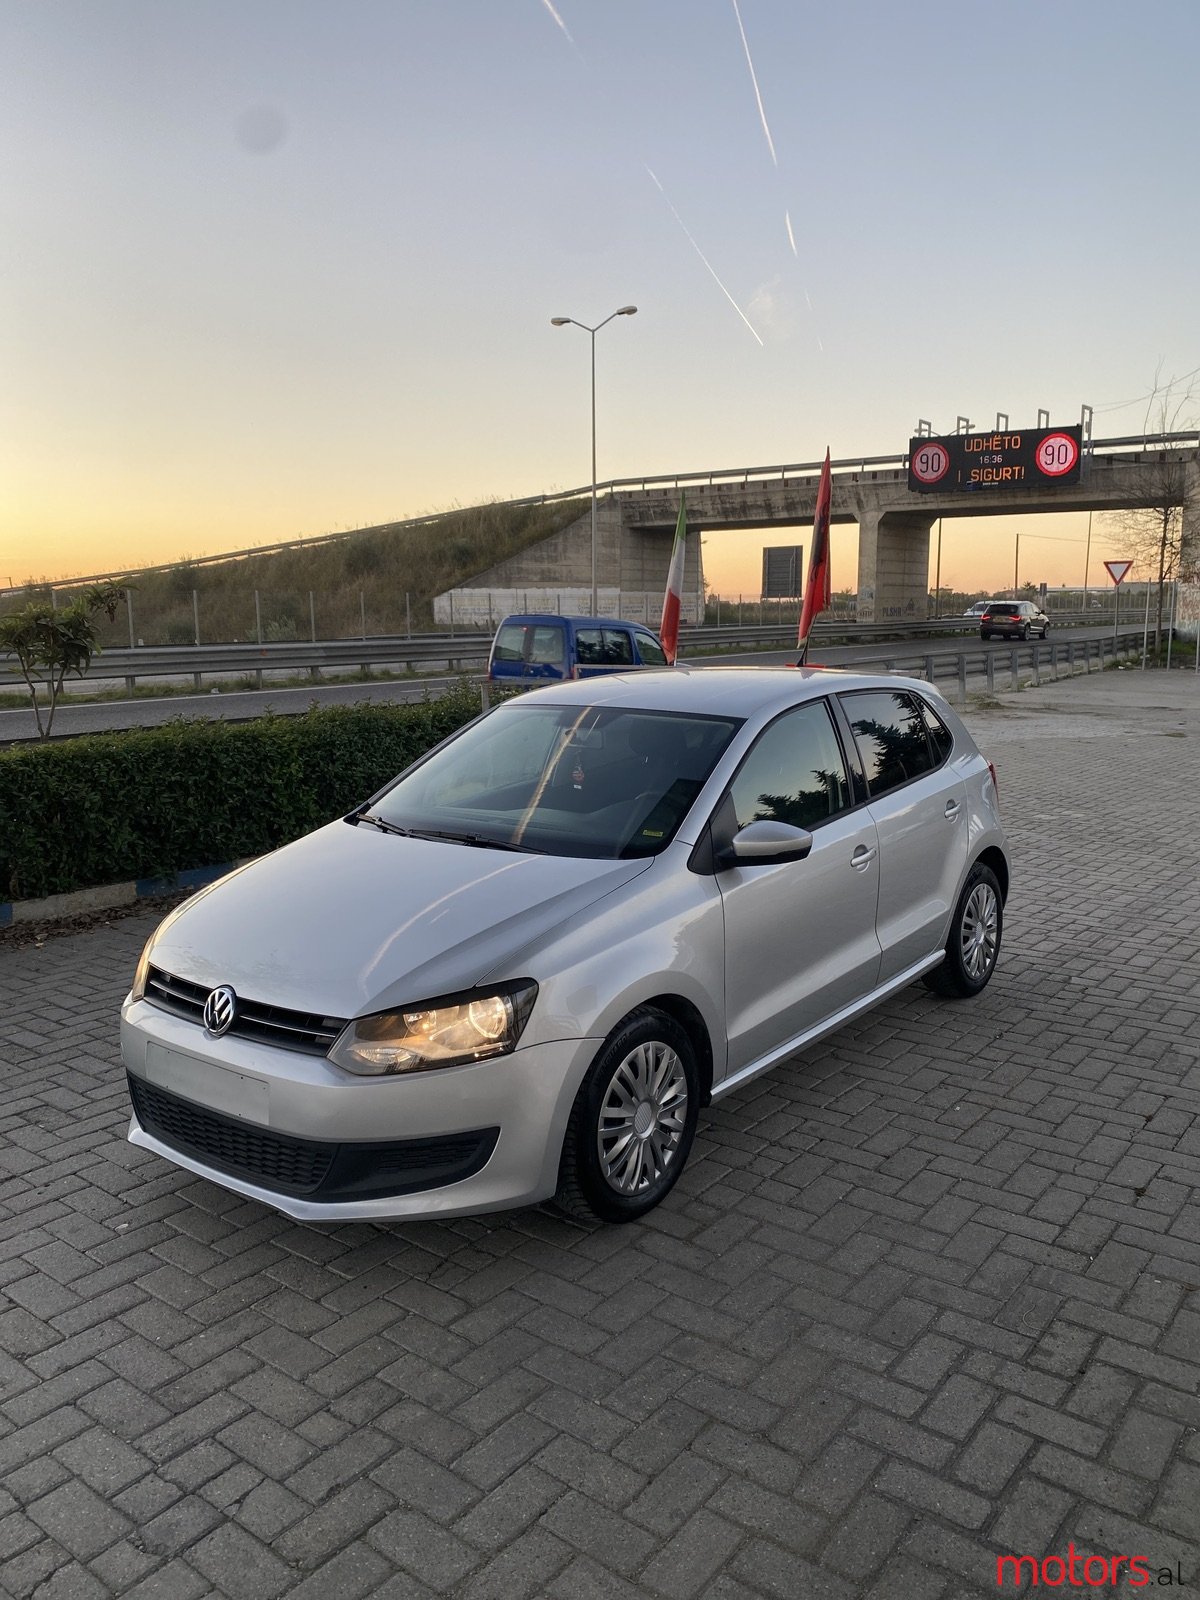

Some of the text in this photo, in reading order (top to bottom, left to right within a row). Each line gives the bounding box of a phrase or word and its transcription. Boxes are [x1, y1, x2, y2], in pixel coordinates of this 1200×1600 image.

[964, 434, 1021, 452] UDHËTO
[919, 452, 941, 473] 90
[979, 454, 1003, 465] 16:36
[1044, 443, 1068, 466] 90
[970, 466, 1025, 482] SIGURT!
